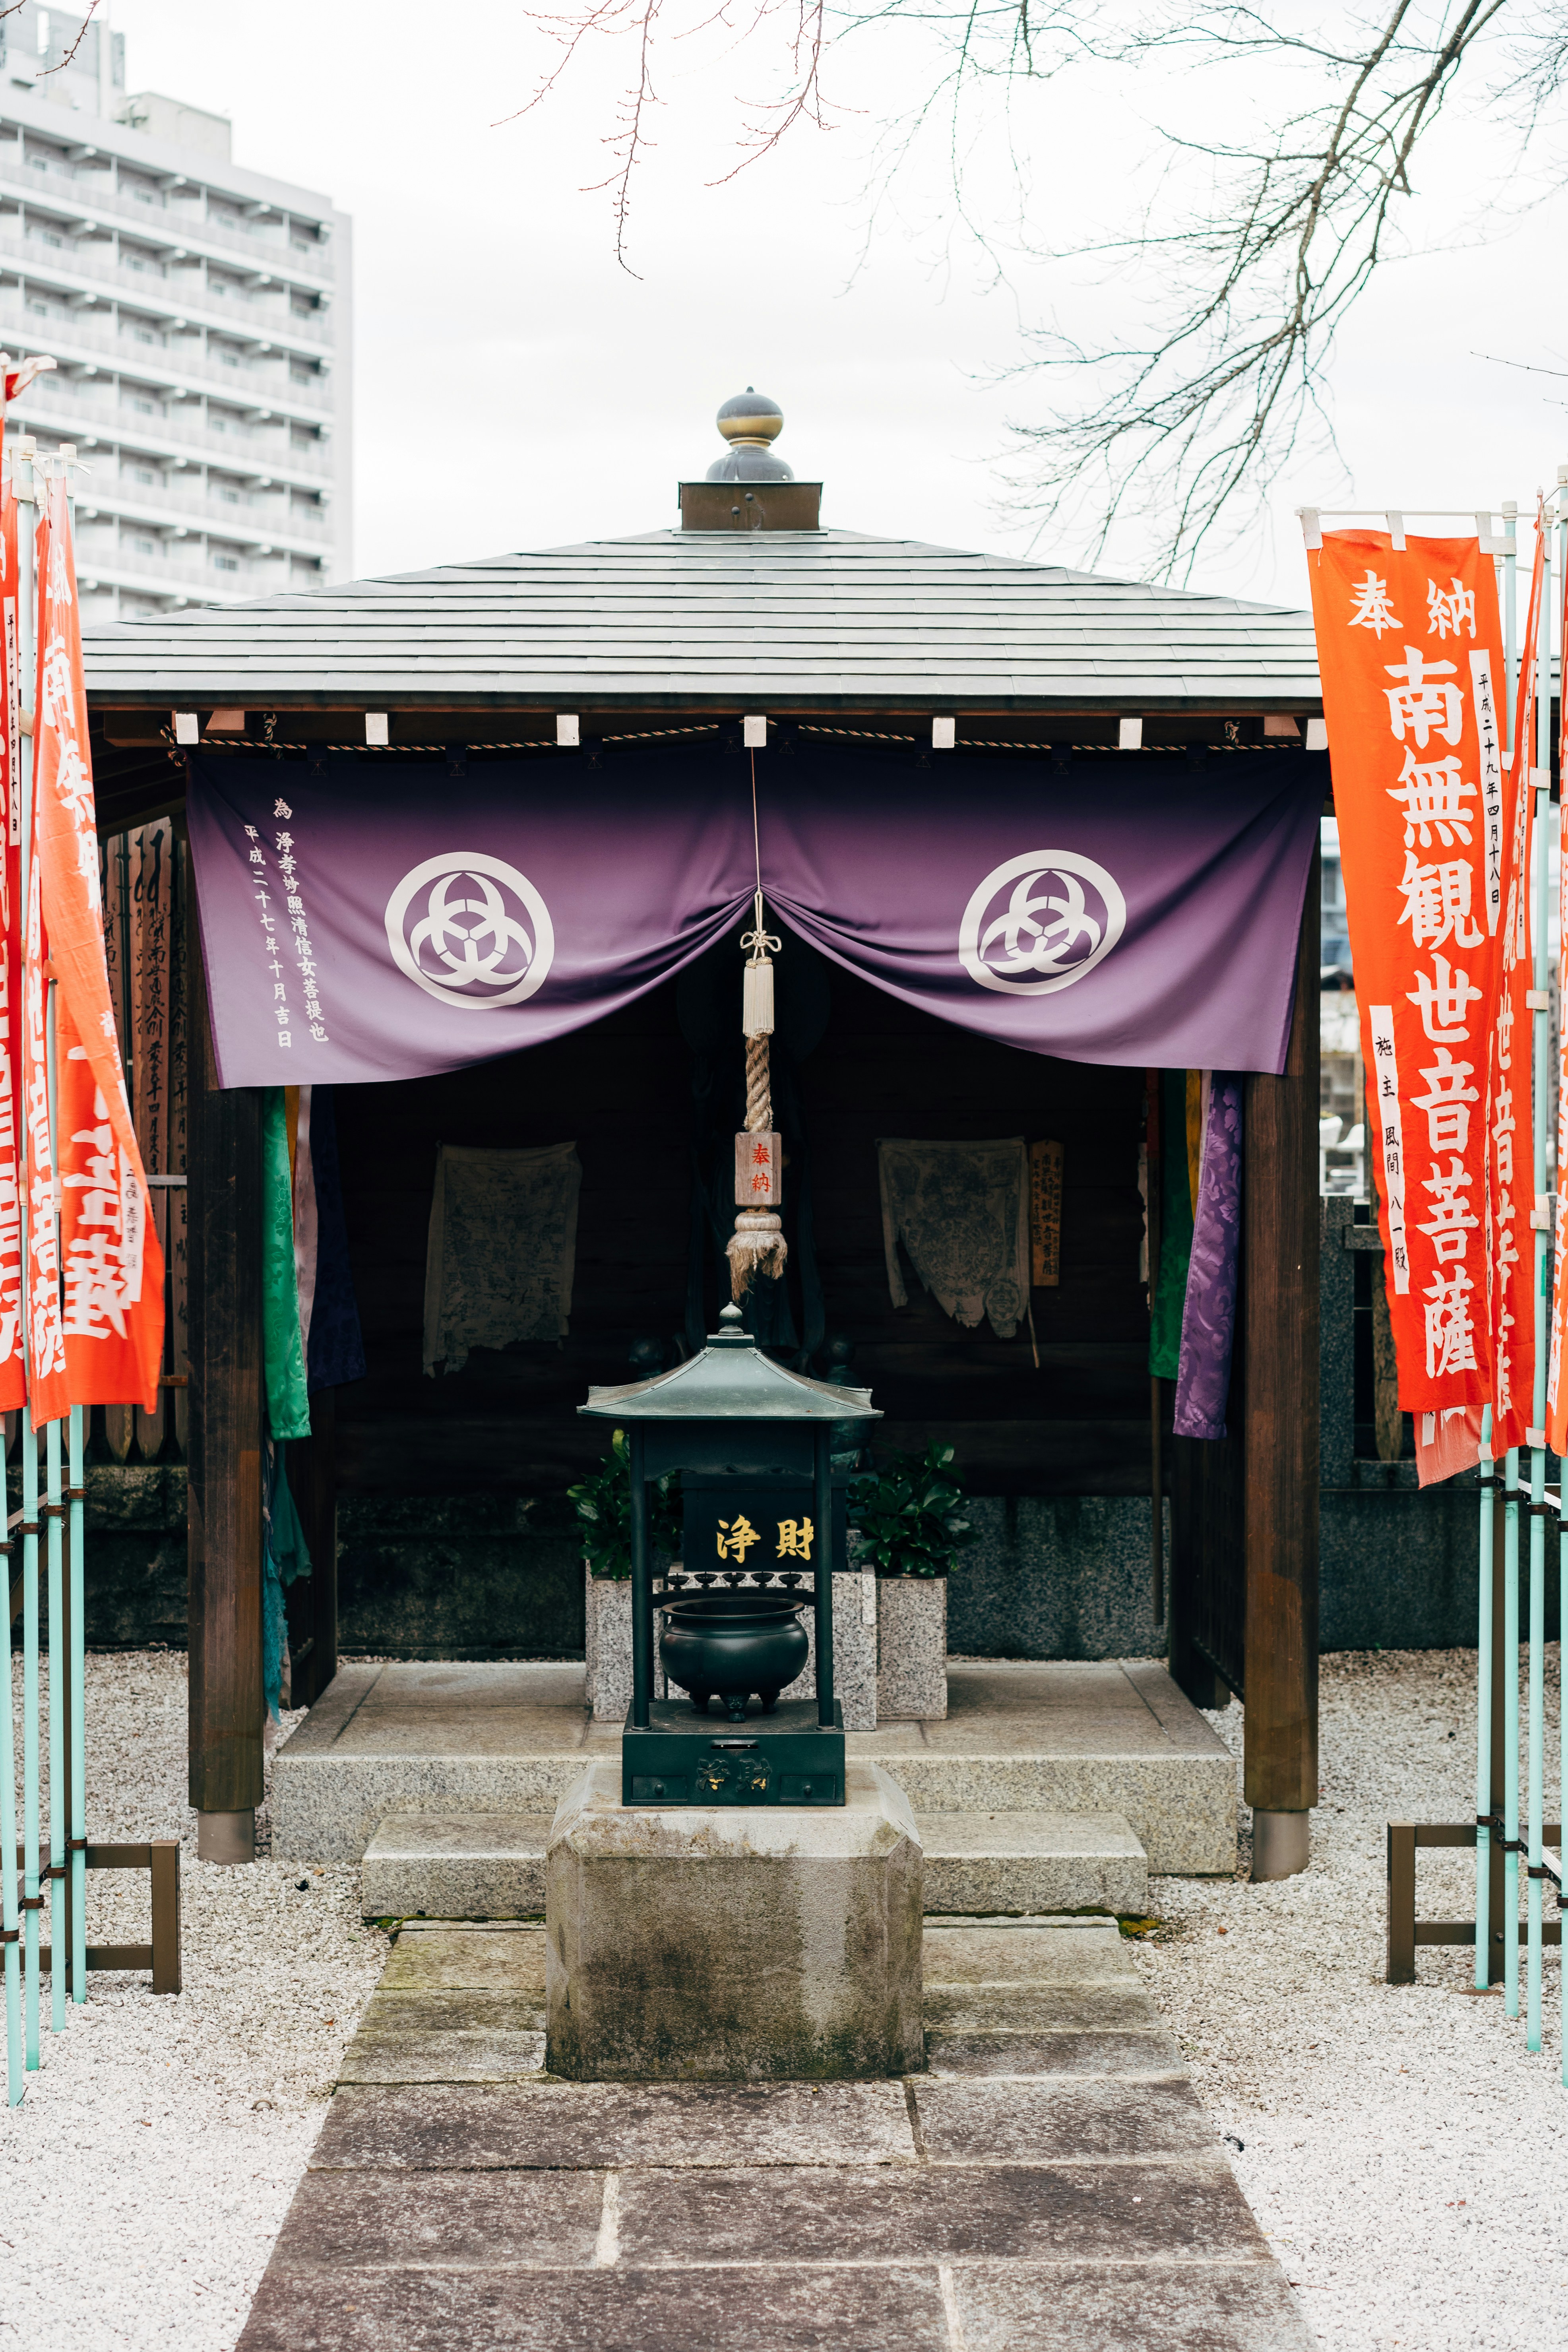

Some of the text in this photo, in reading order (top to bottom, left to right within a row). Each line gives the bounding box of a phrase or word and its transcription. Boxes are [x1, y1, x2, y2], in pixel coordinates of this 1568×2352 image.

[1348, 570, 1477, 640] 奉納
[1478, 674, 1500, 903] 平成二十九年四月十八日
[244, 825, 292, 1048] 平成二十七年十月吉日
[1382, 645, 1485, 1379] 南無観世音菩薩
[751, 1143, 771, 1192] 奉納
[716, 1514, 814, 1563] 浄財
[697, 1758, 771, 1792] 浄財
